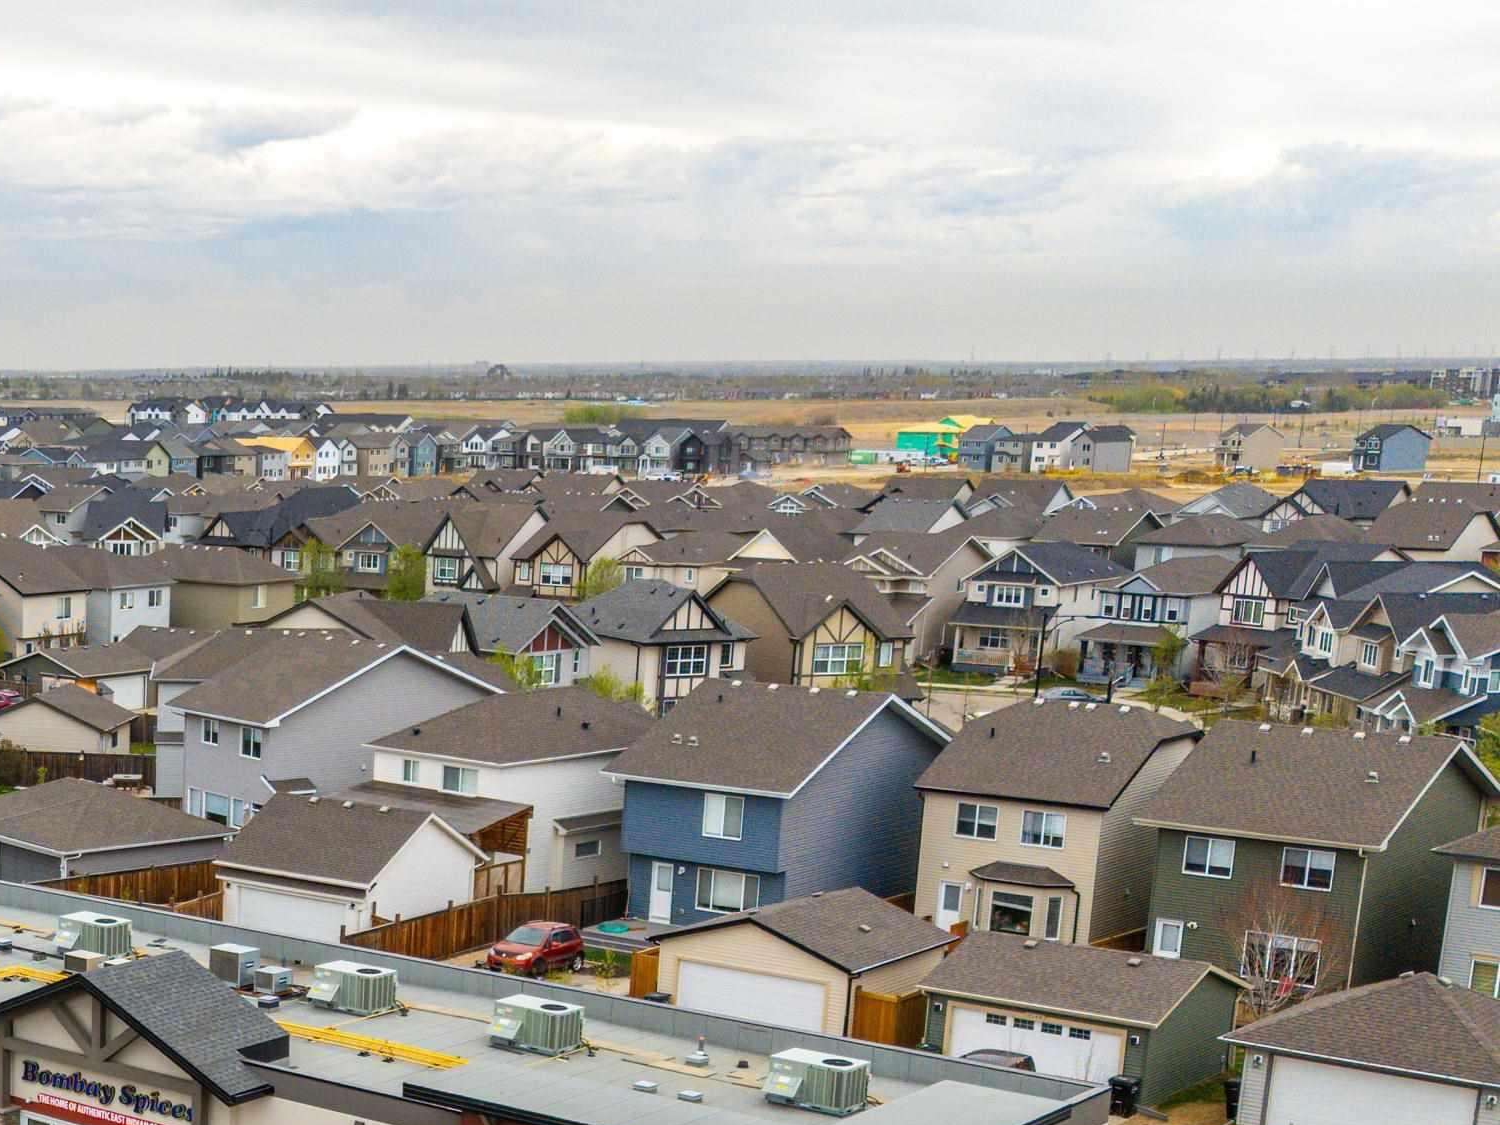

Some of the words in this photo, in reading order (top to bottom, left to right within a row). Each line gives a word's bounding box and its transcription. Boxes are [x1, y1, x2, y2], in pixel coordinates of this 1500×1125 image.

[21, 1060, 116, 1105] Bombay
[119, 1084, 193, 1122] Spices
[40, 1094, 50, 1105] THE
[50, 1096, 69, 1110] HOME
[78, 1104, 111, 1121] AUTHENTIC
[110, 1113, 126, 1125] EAST
